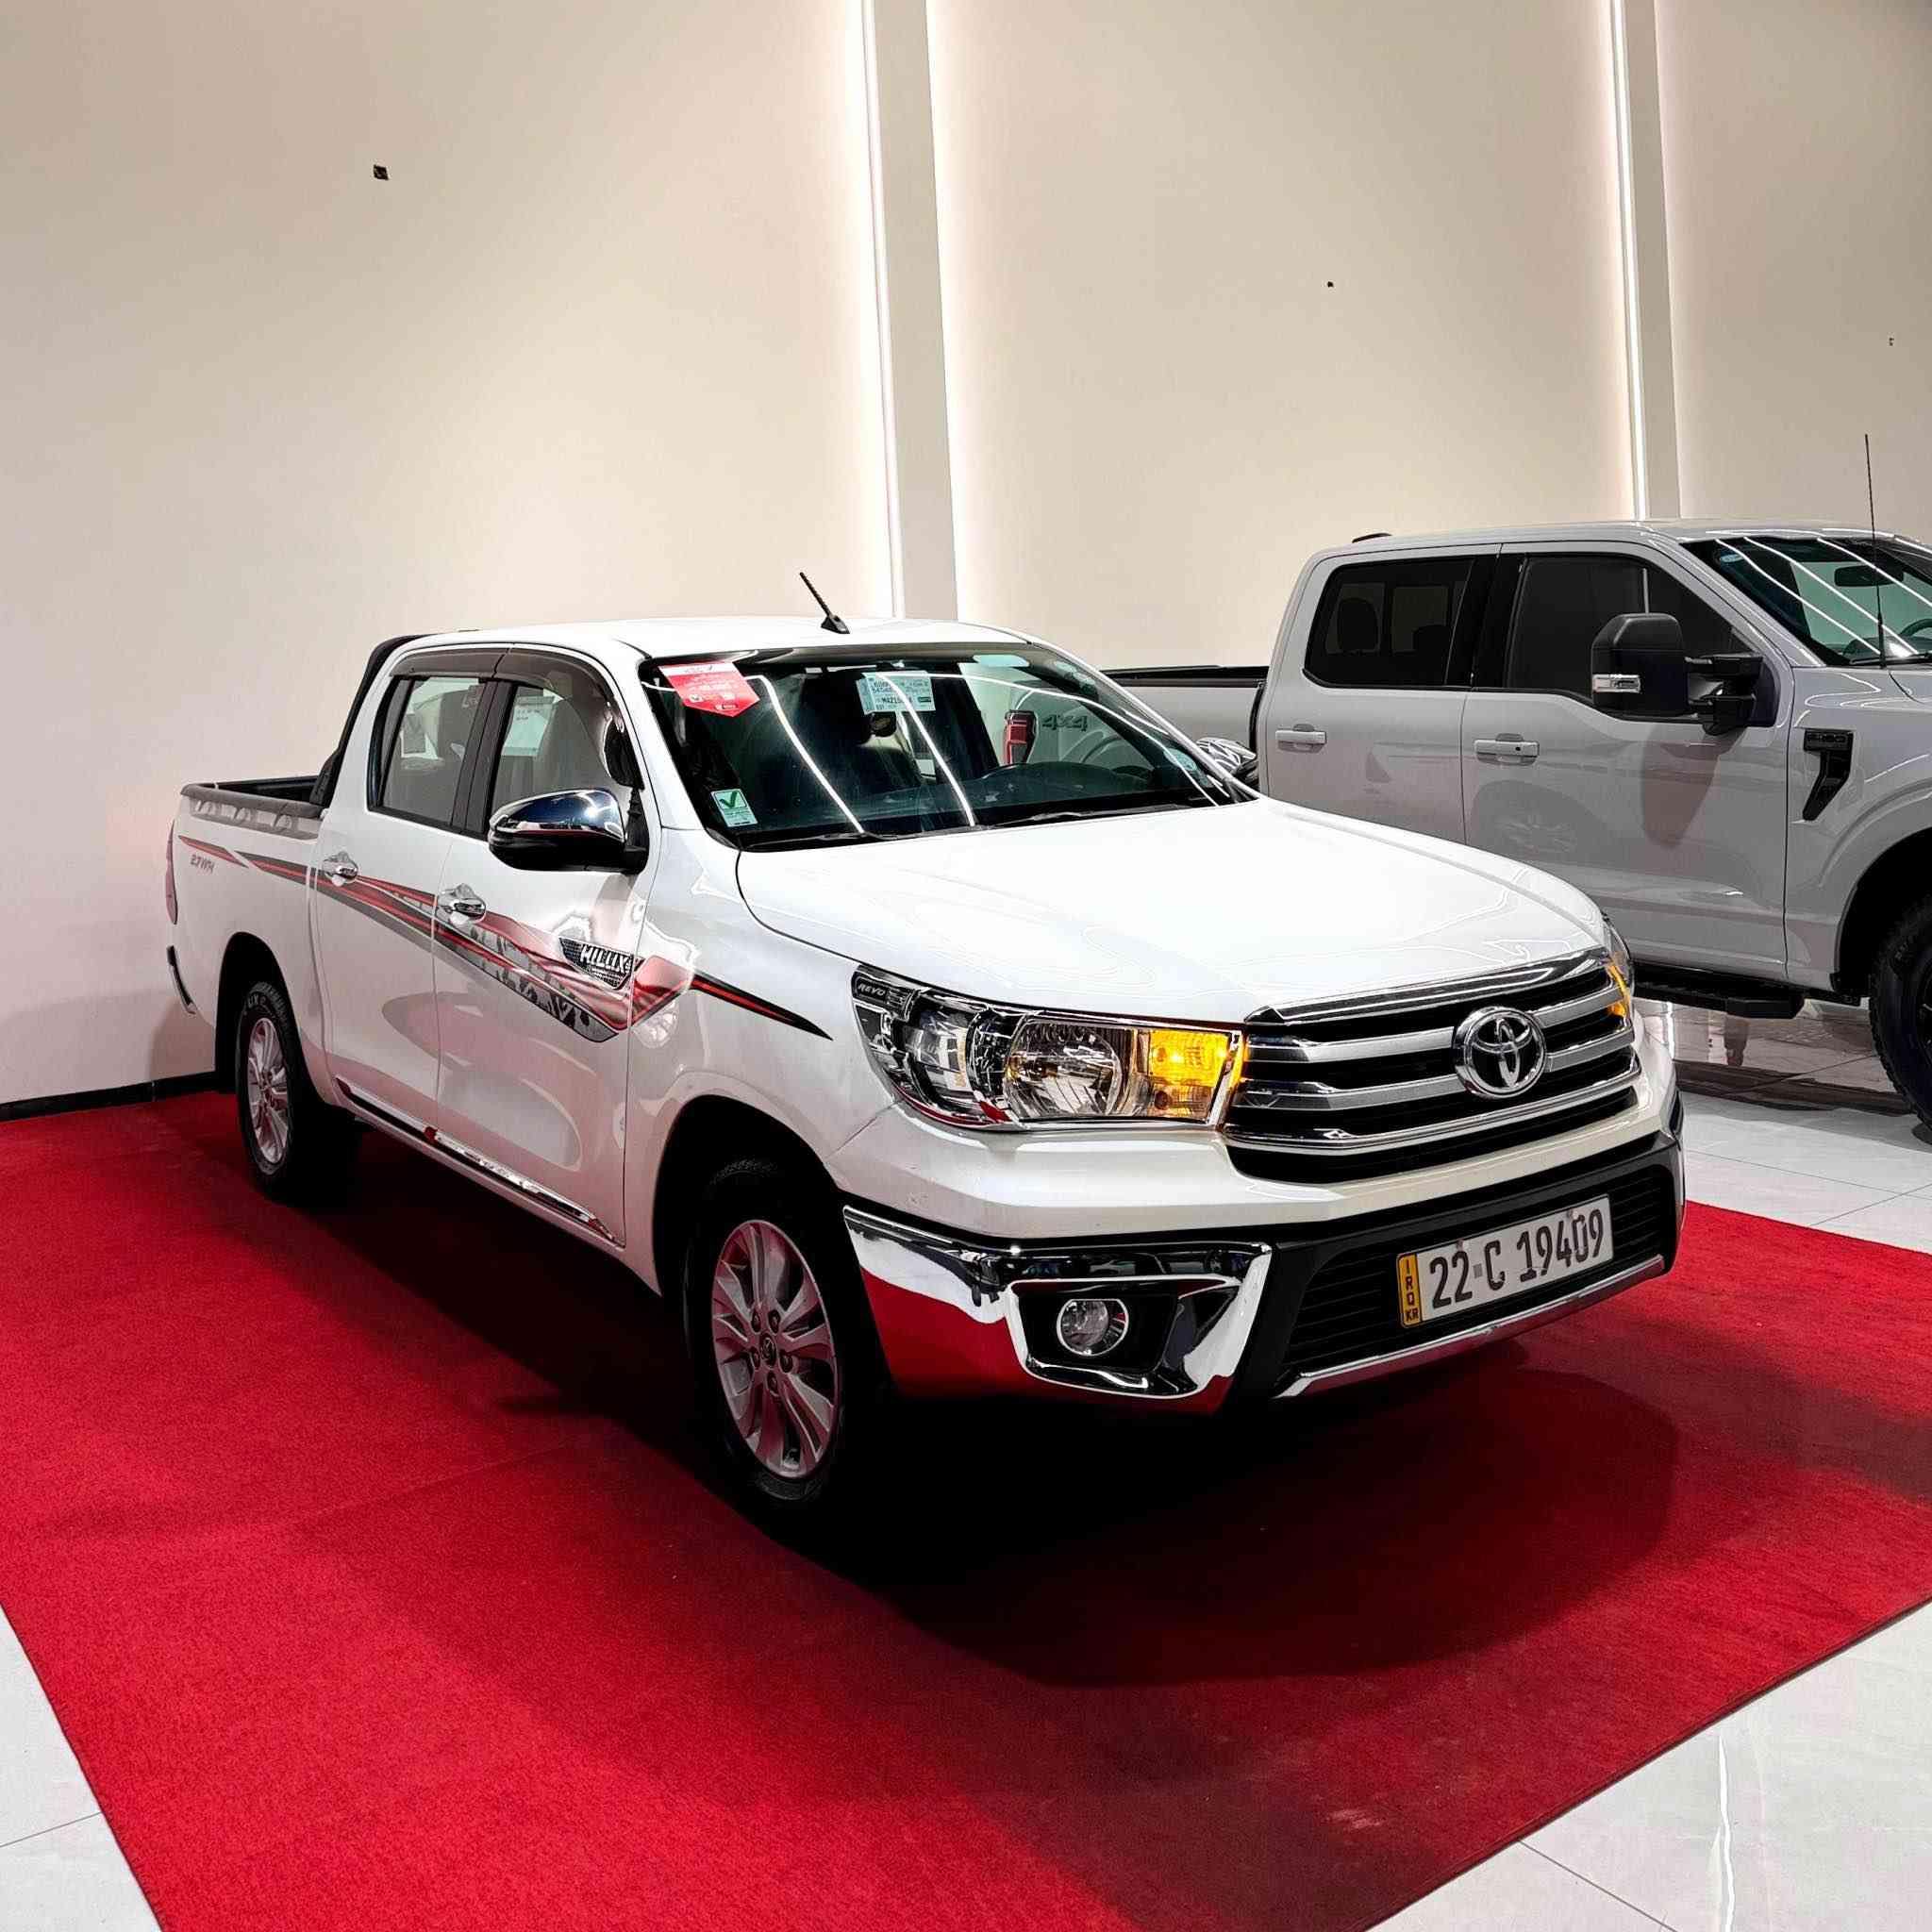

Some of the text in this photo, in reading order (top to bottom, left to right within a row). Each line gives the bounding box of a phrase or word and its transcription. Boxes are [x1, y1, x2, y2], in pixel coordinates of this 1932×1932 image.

[580, 945, 629, 974] HILUX
[858, 982, 886, 996] REVO
[1429, 1208, 1604, 1308] 22 C 19409
